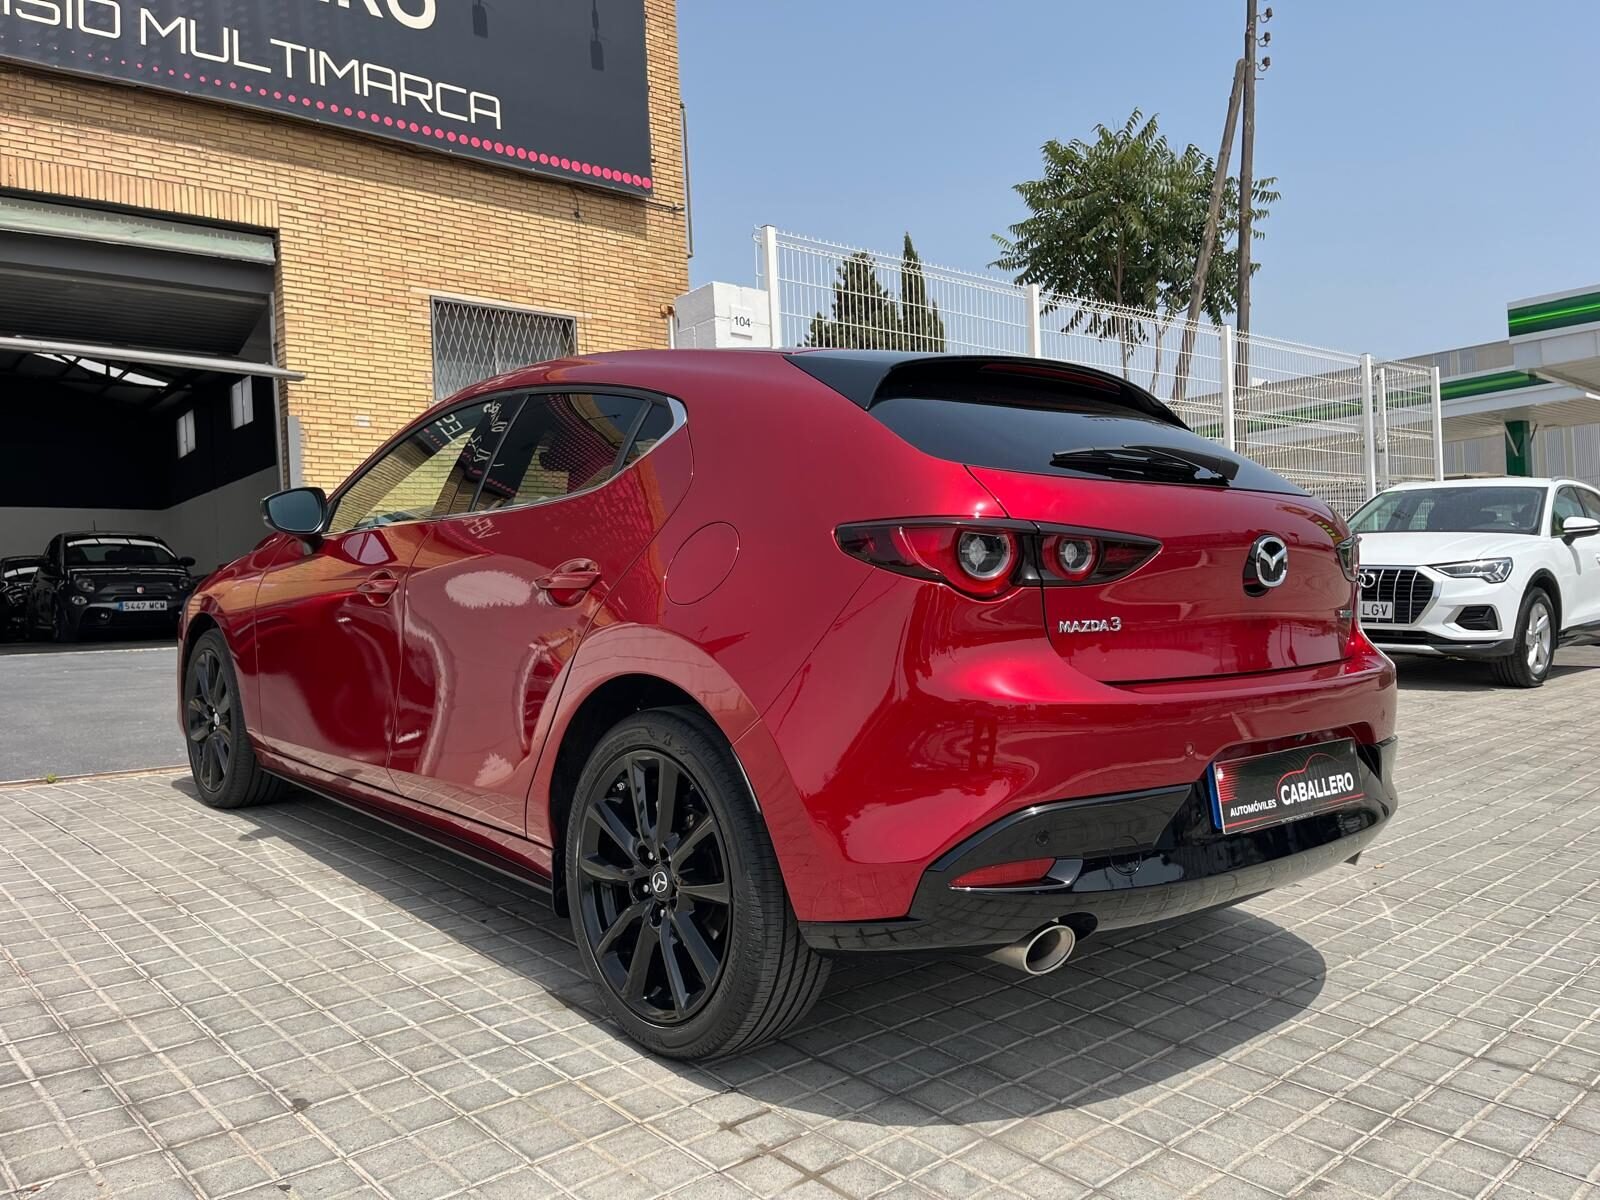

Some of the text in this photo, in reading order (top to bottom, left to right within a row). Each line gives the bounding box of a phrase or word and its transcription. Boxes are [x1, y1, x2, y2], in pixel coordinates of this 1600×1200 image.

[3, 0, 502, 130] SIO MULTIMARCA
[734, 315, 751, 328] 104
[1362, 603, 1389, 617] LGV
[1058, 616, 1122, 633] MAZDA3
[1280, 772, 1354, 806] CABALLERO
[1230, 798, 1277, 817] AUTOMÓVILES
